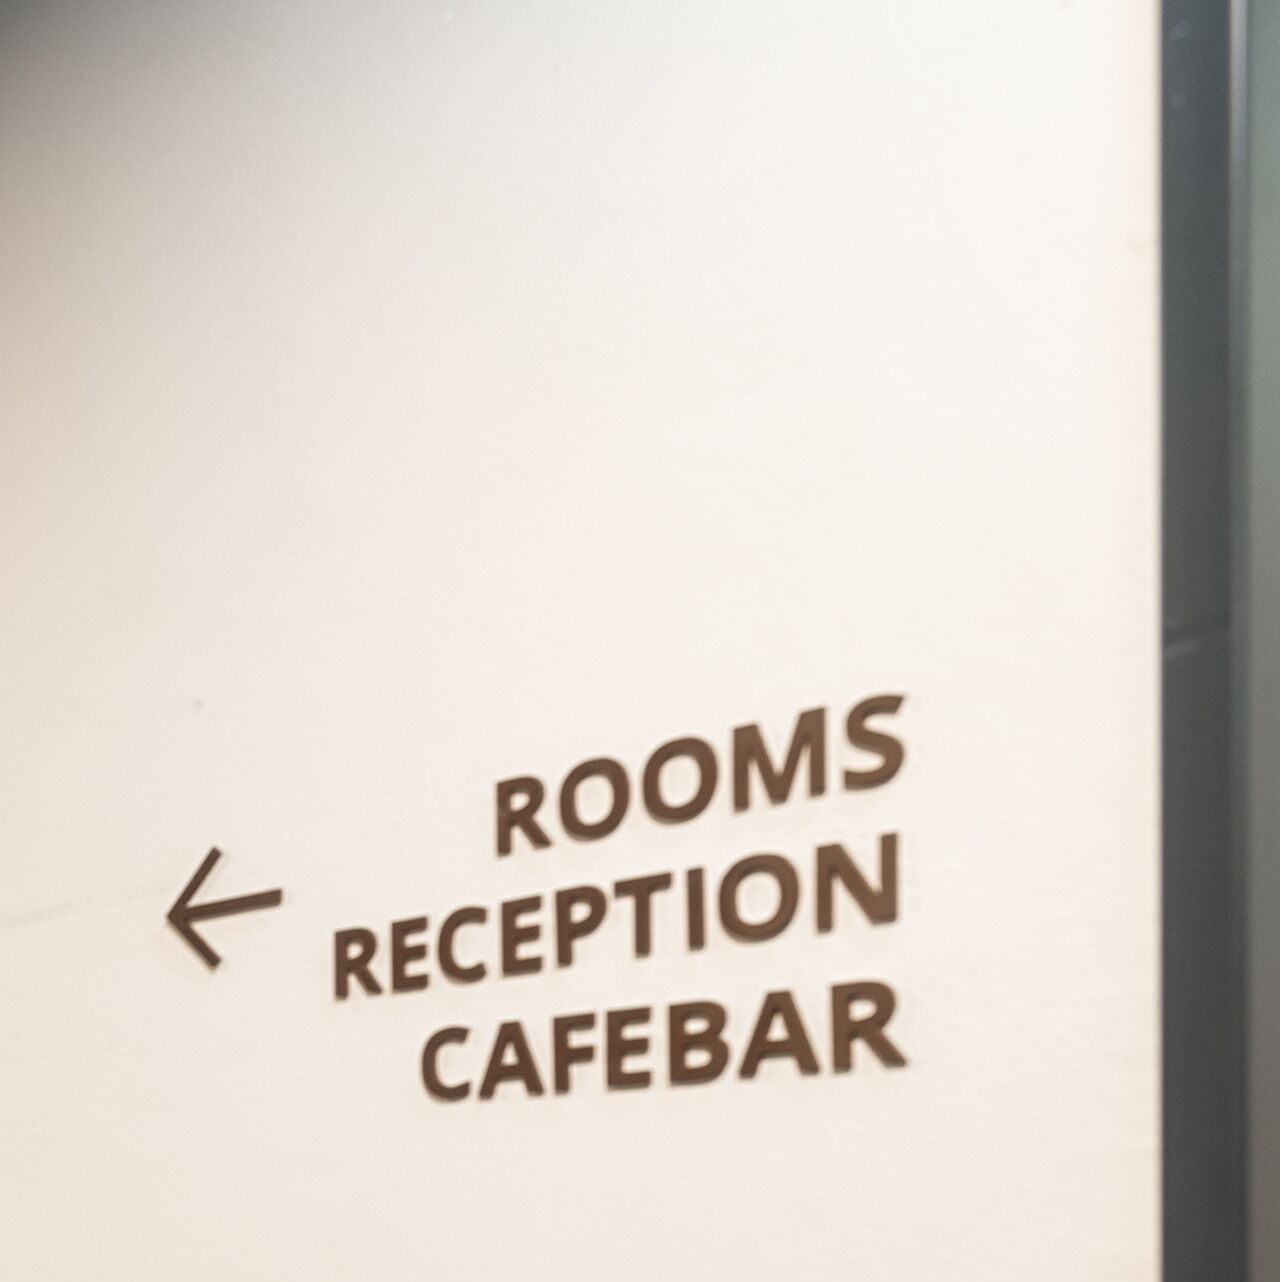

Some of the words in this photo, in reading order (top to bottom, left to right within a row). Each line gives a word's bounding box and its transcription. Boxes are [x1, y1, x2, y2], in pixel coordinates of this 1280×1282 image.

[495, 693, 907, 859] ROOMS
[332, 831, 901, 1001] RECEPTION
[420, 980, 908, 1103] CAFEBAR
